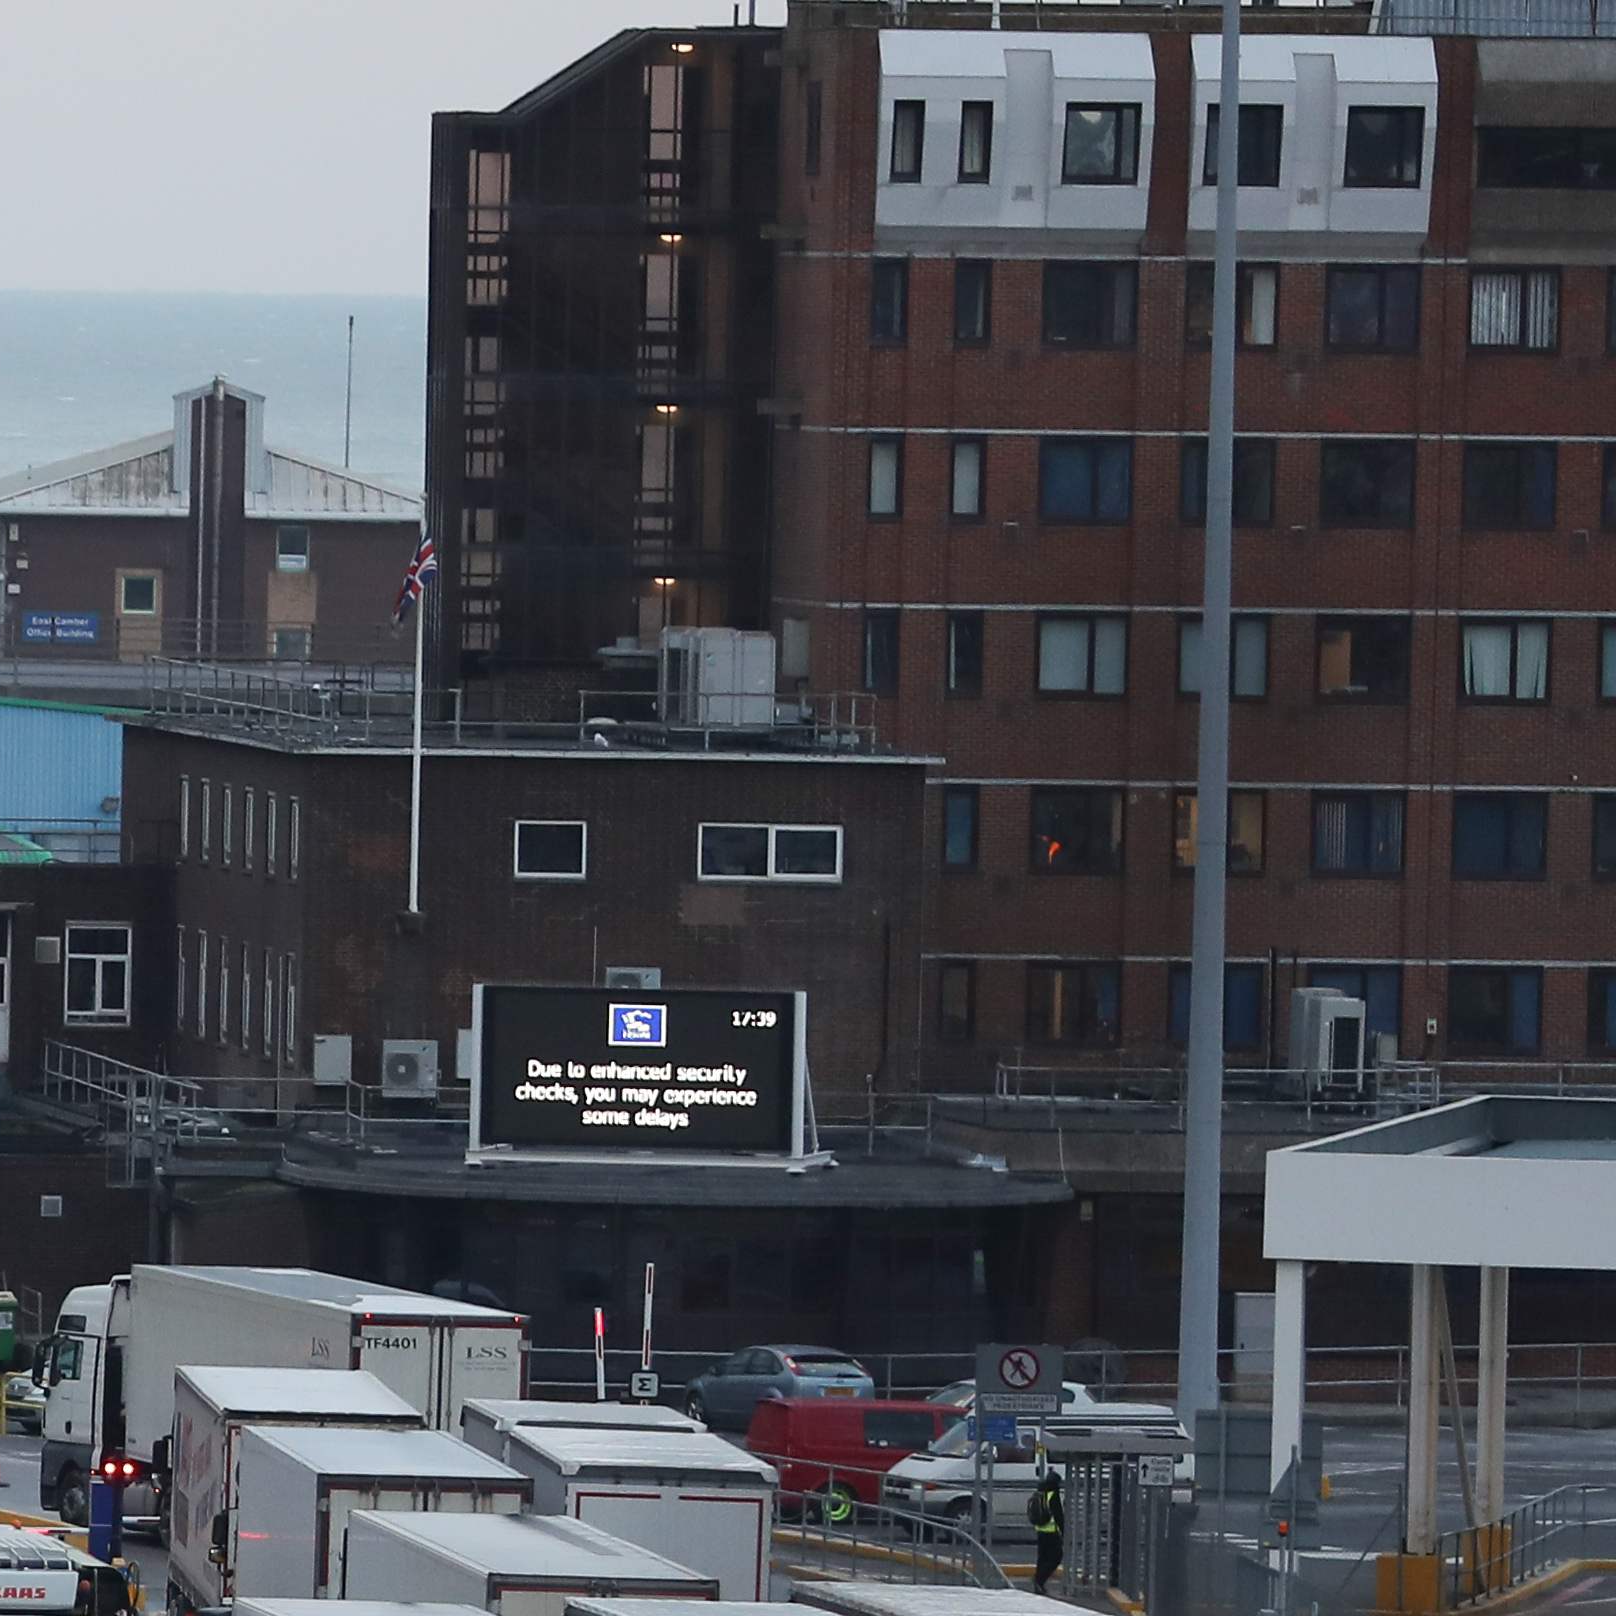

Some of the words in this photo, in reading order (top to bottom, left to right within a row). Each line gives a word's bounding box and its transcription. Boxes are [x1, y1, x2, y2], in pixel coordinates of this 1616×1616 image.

[732, 1010, 777, 1028] 17:39
[527, 1059, 562, 1079] Due
[567, 1061, 585, 1079] to
[590, 1062, 672, 1081] enhanced
[676, 1064, 747, 1086] security
[514, 1081, 579, 1105] checks,
[584, 1085, 616, 1105] you
[621, 1086, 659, 1107] may
[663, 1088, 758, 1108] experience
[581, 1109, 629, 1125] some
[634, 1108, 690, 1130] delays
[365, 1337, 417, 1350] TF4401
[466, 1347, 508, 1359] LSS
